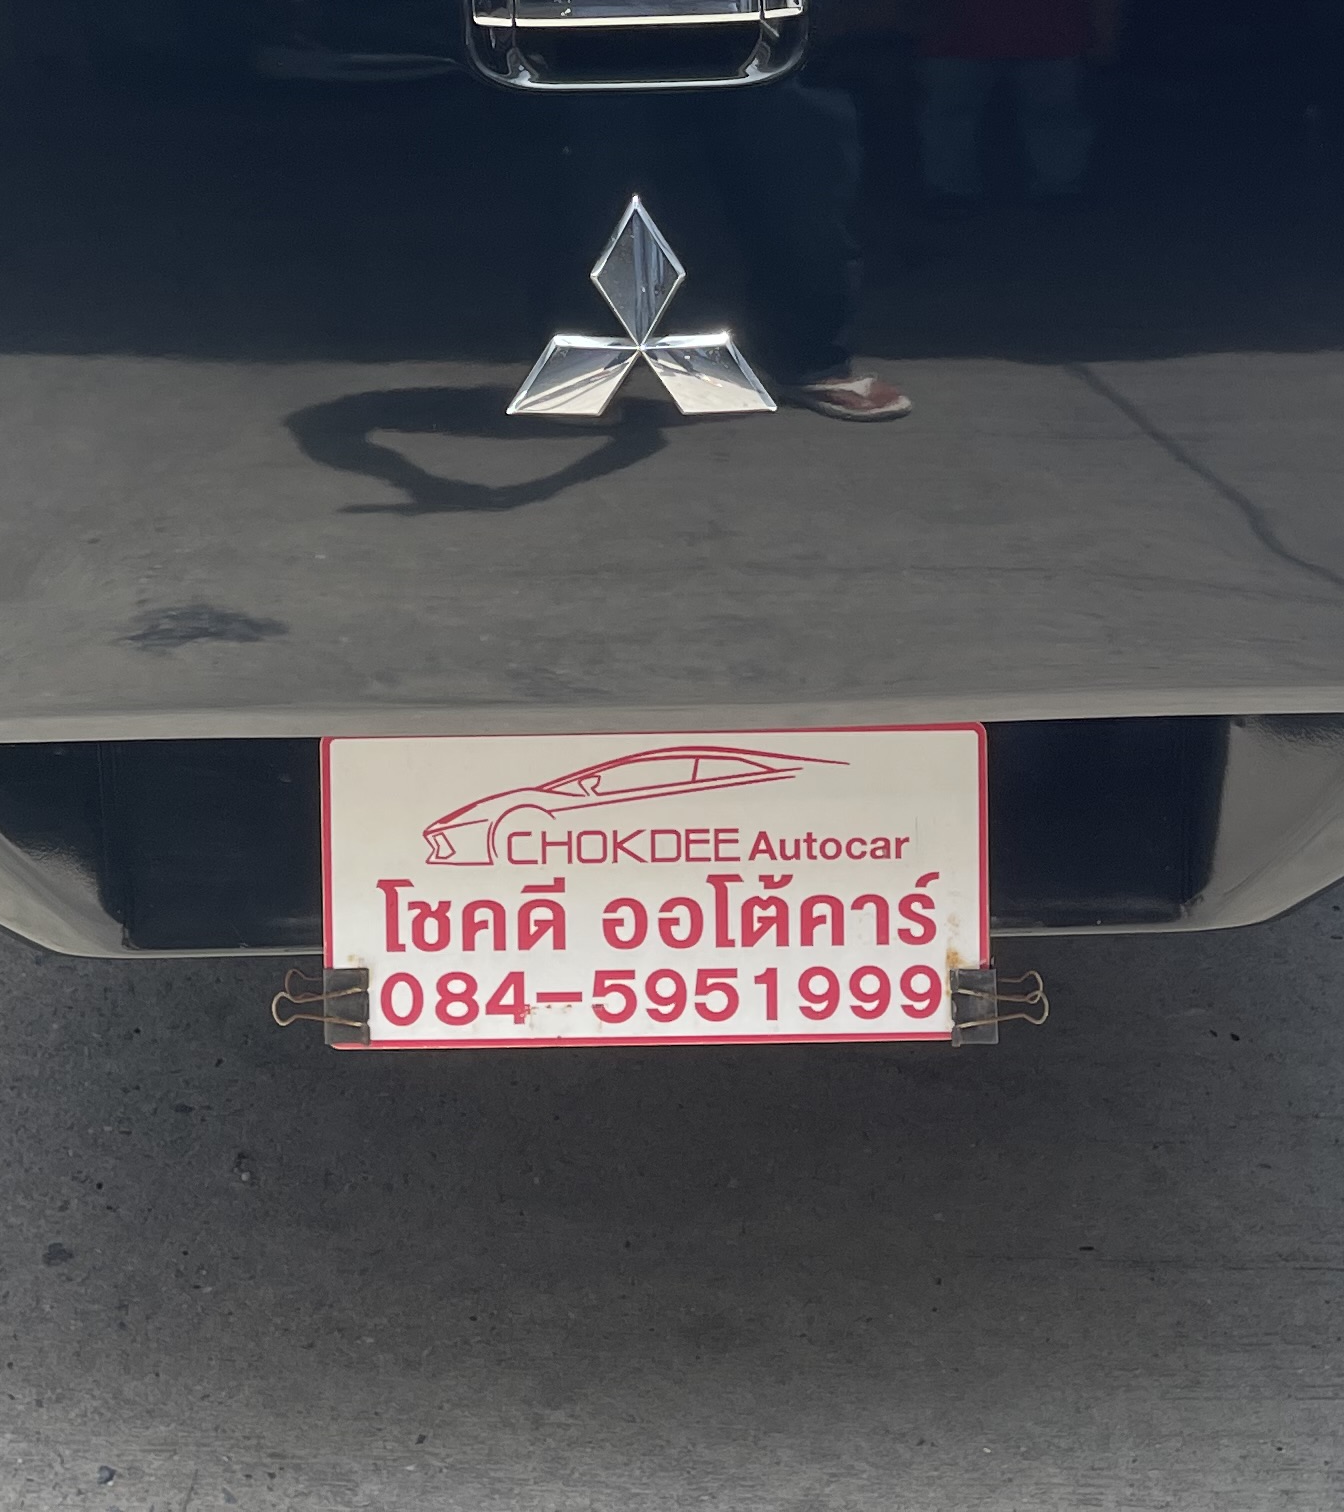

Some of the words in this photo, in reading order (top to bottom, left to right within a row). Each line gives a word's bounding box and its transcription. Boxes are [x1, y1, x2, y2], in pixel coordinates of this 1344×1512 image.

[506, 827, 740, 865] CHOKDEE
[747, 830, 910, 863] Autocar
[376, 876, 568, 953] โชคดี
[602, 870, 940, 951] ออโต้คาร์
[379, 965, 944, 1027] 084-5951999
